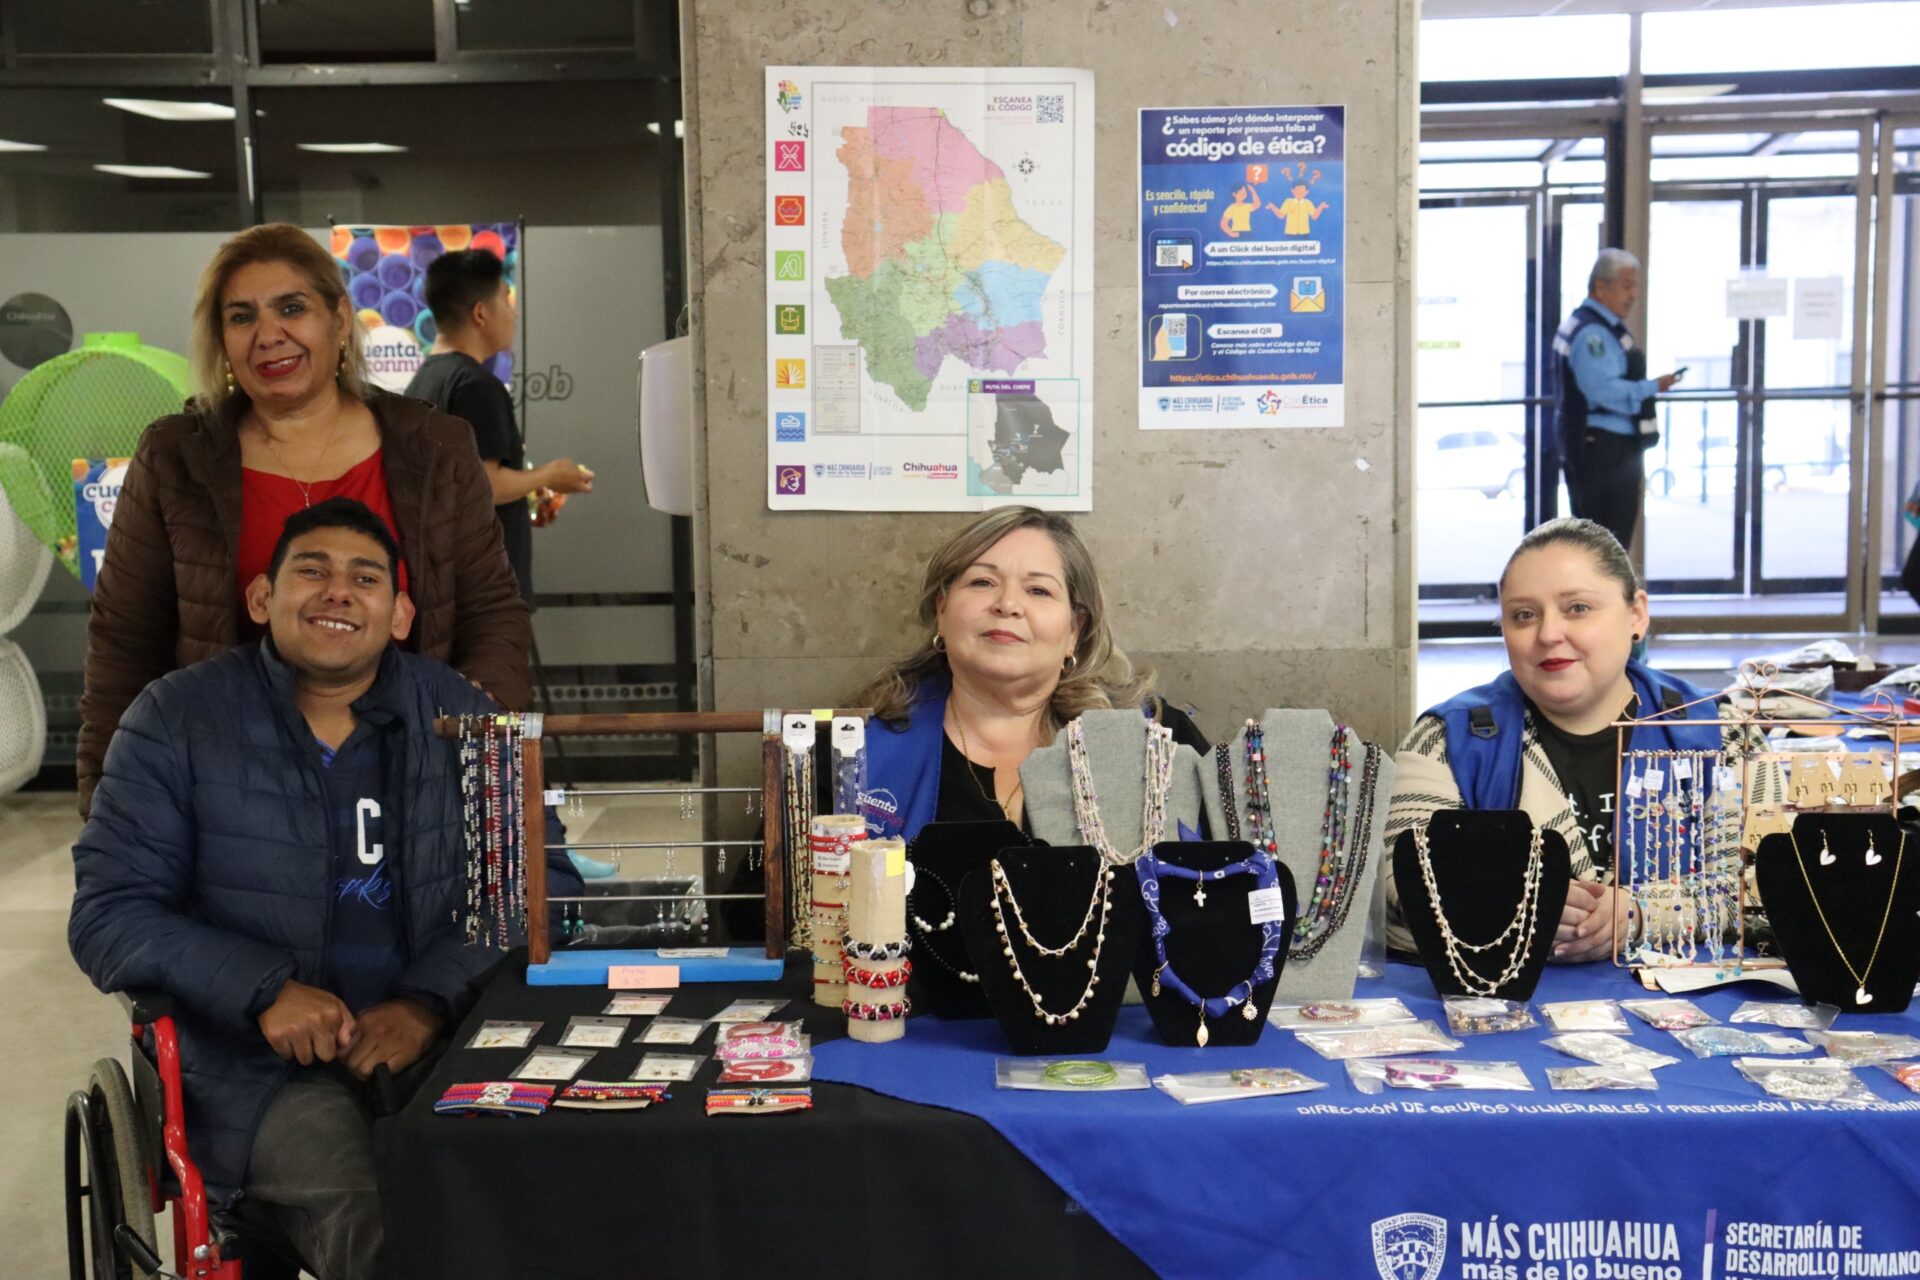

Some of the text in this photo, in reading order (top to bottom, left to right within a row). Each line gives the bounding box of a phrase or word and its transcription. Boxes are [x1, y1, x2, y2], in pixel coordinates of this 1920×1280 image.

[998, 103, 1032, 111] CÓDIGO
[1201, 115, 1226, 124] cómo
[1228, 115, 1243, 125] y/o
[1244, 113, 1274, 123] dónde
[1275, 113, 1324, 124] interponer
[1178, 123, 1316, 136] un reporte por presunta falta al
[1165, 134, 1326, 161] código de ética?
[1145, 188, 1215, 202] Es sencillo, rápido
[1153, 201, 1207, 217] y confidencial
[1290, 243, 1316, 253] digital
[1184, 288, 1197, 296] Por
[1227, 287, 1271, 295] electrónico
[1260, 327, 1272, 336] QR
[903, 462, 958, 471] Chihuahua
[1598, 792, 1615, 813] I
[1296, 1103, 1398, 1115] DIRECCIÓN
[1400, 1101, 1428, 1113] DE
[1430, 1102, 1510, 1115] GRUPOS
[1512, 1102, 1650, 1115] VULNERABLES
[1650, 1103, 1664, 1113] Y
[1667, 1100, 1789, 1114] PREVENCIÓN
[1790, 1101, 1806, 1112] A
[1461, 1214, 1680, 1261] MÁS CHIHUAHUA
[1725, 1220, 1863, 1250] SECRETARÍA DE
[1462, 1257, 1682, 1280] más de lo bueno
[1725, 1248, 1920, 1277] DESARROLLO HUMANO
